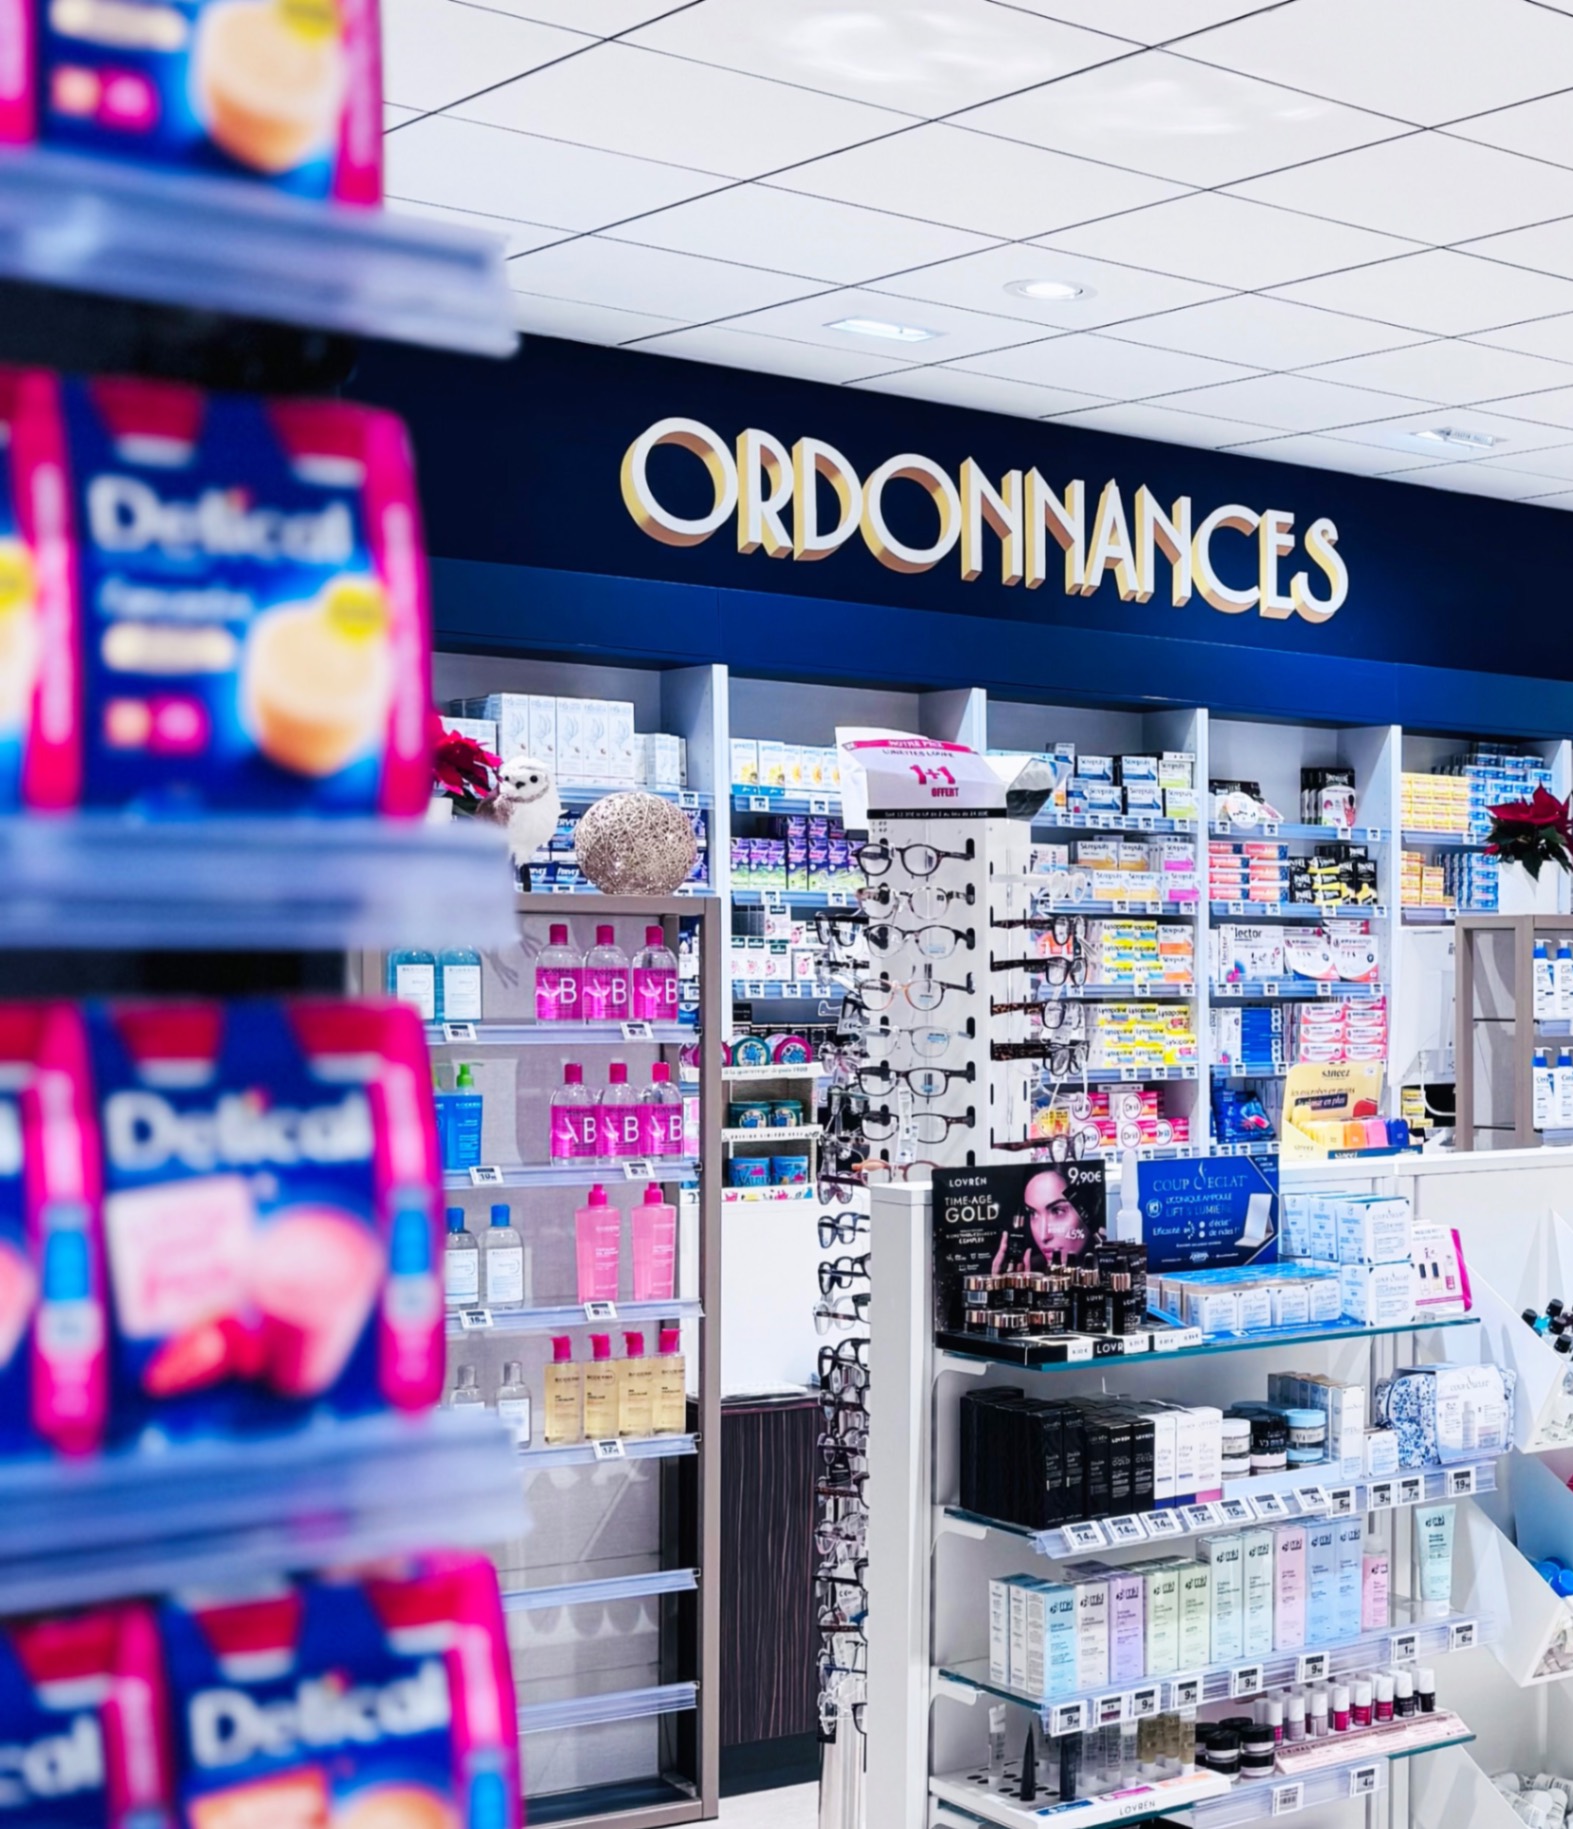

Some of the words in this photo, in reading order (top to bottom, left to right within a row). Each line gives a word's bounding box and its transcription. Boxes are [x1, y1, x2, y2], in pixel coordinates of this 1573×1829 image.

[620, 417, 1348, 623] ORDONNANCES
[910, 764, 956, 784] 1+1
[931, 787, 959, 798] OFFERT
[1234, 928, 1262, 938] lector
[1068, 1166, 1102, 1186] 9,90€
[1153, 1178, 1190, 1192] COUP
[945, 1194, 992, 1206] TIME-AGE
[945, 1203, 1000, 1224] GOLD
[1097, 1342, 1124, 1354] LOVR
